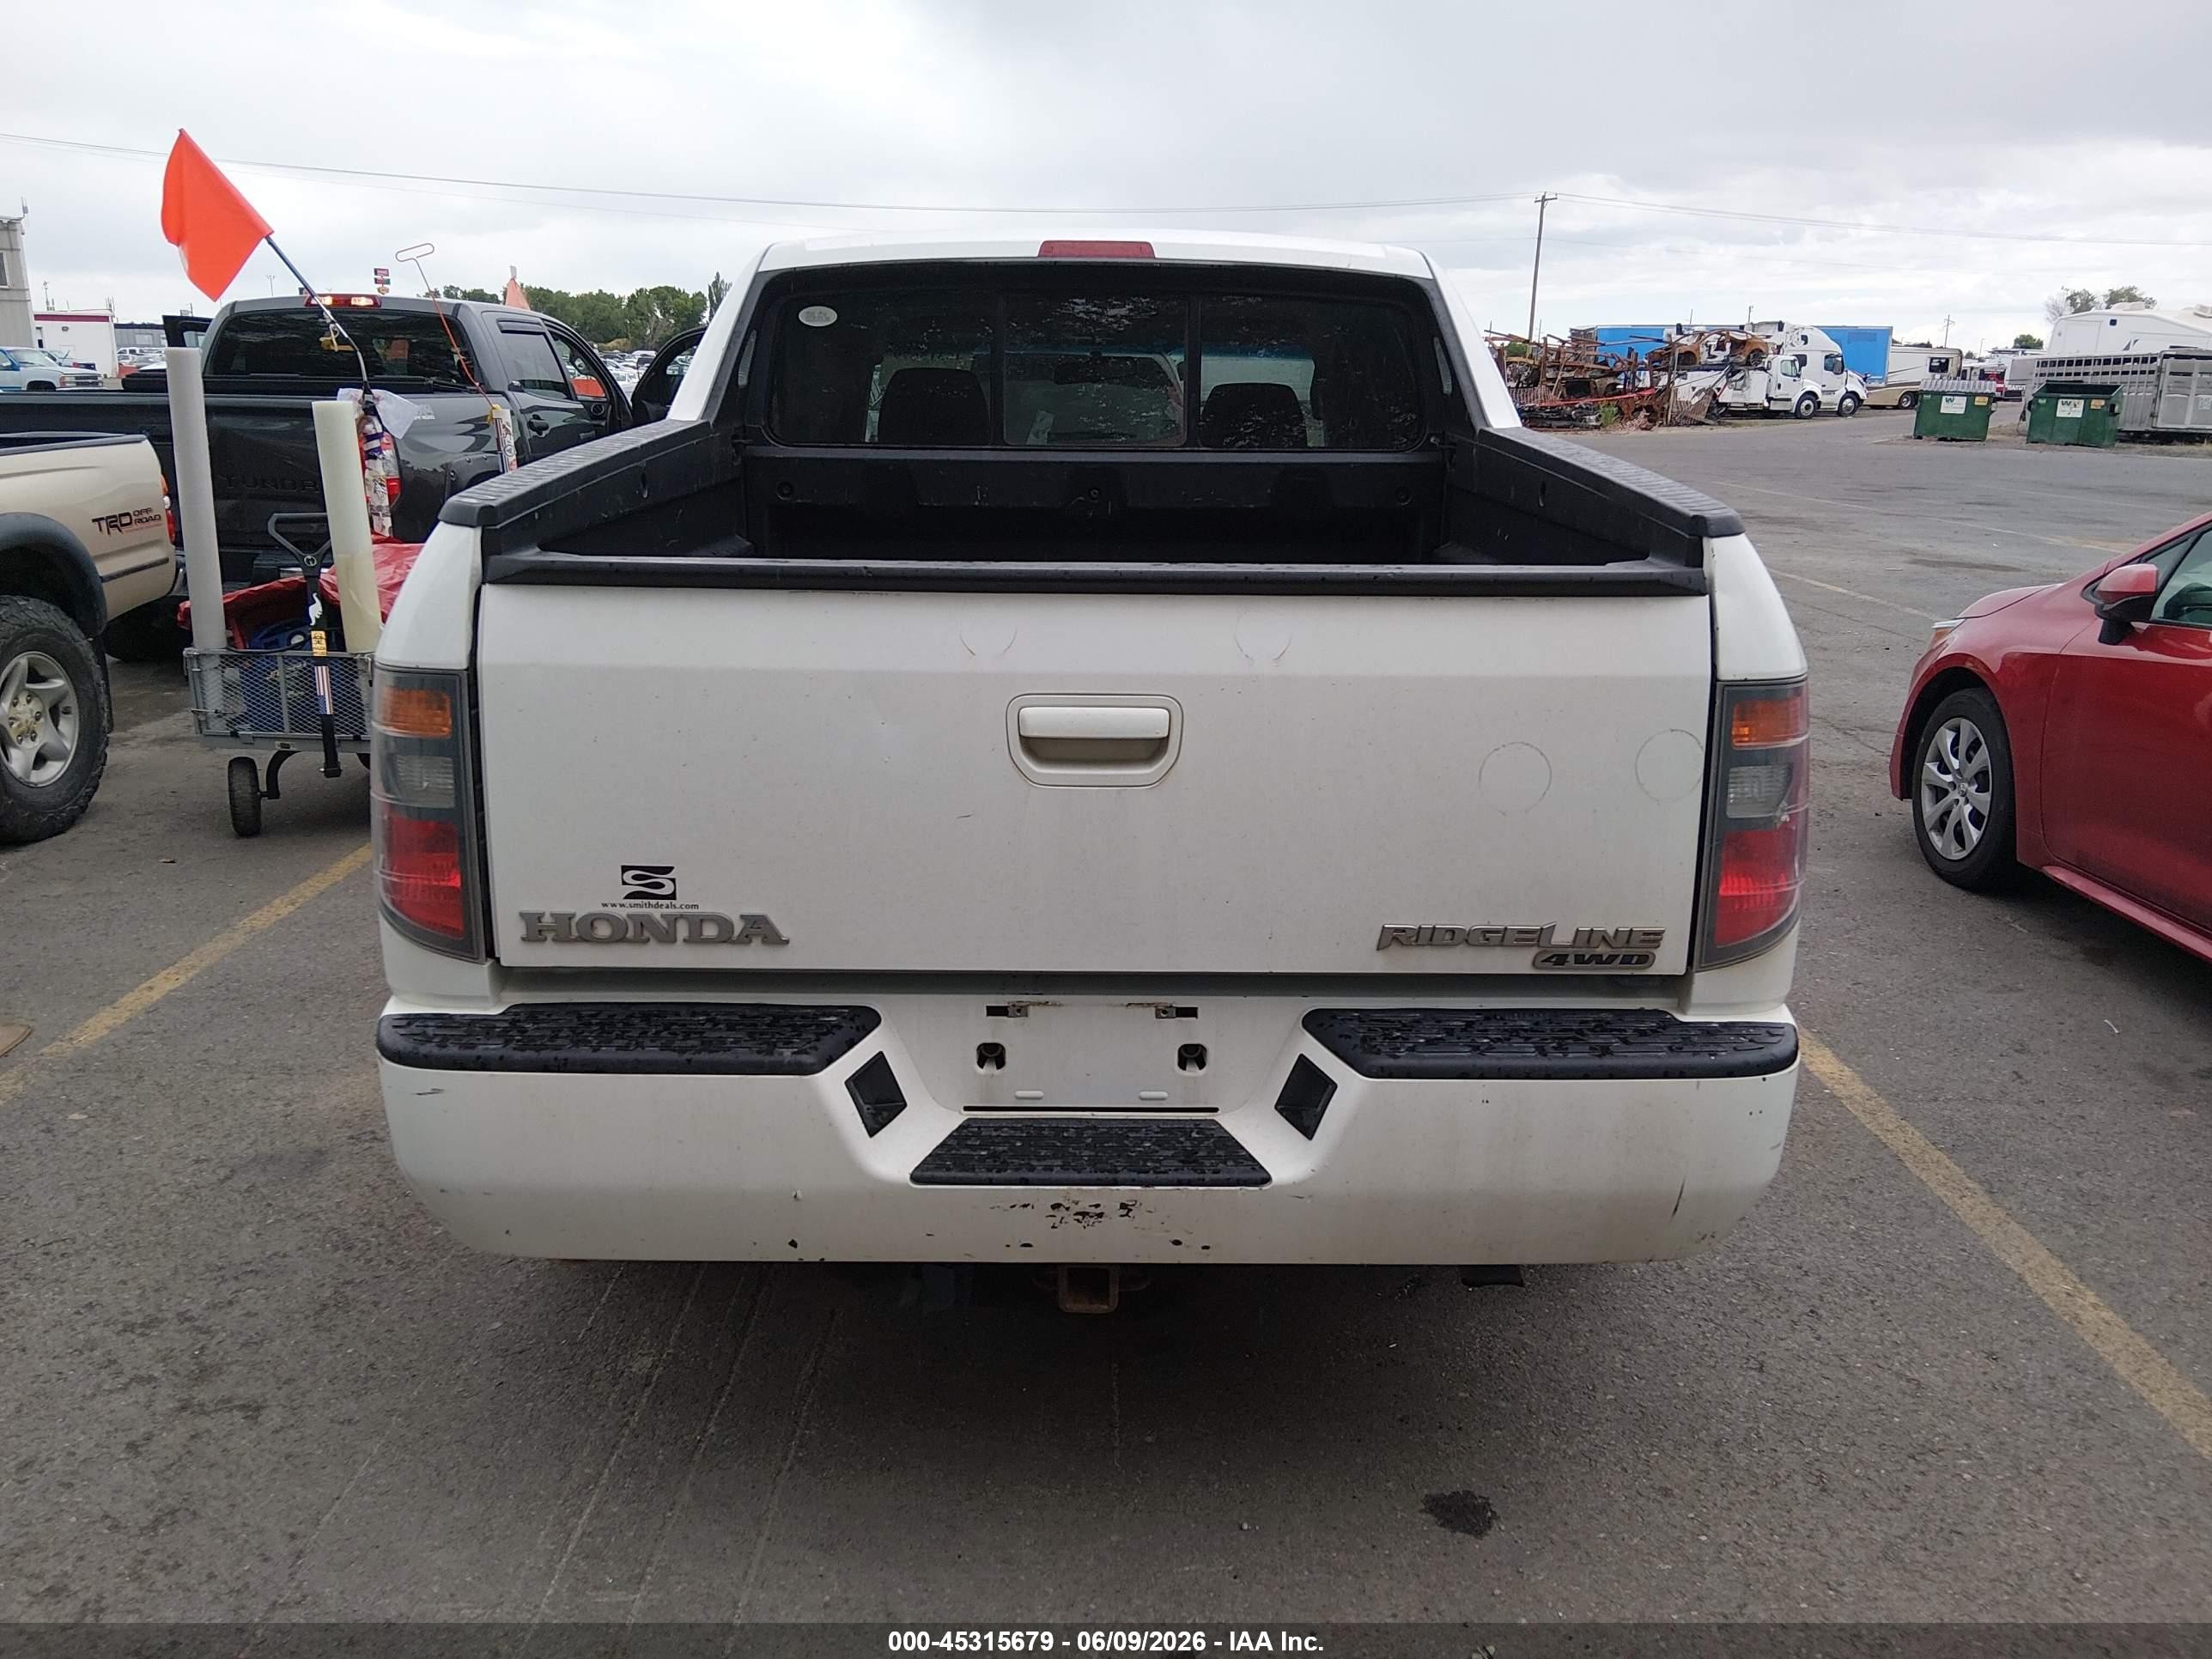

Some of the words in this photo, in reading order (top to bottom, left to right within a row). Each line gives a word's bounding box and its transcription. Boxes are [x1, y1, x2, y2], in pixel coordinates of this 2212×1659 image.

[218, 475, 321, 493] TUNDR
[132, 507, 153, 516] OFF
[134, 514, 161, 525] ROAD
[91, 512, 133, 536] TRD
[601, 900, 700, 910] www.smithdeals.com
[519, 911, 791, 945] HONDA
[1376, 921, 1666, 951] RIDGELINE
[1538, 951, 1652, 967] 4WD
